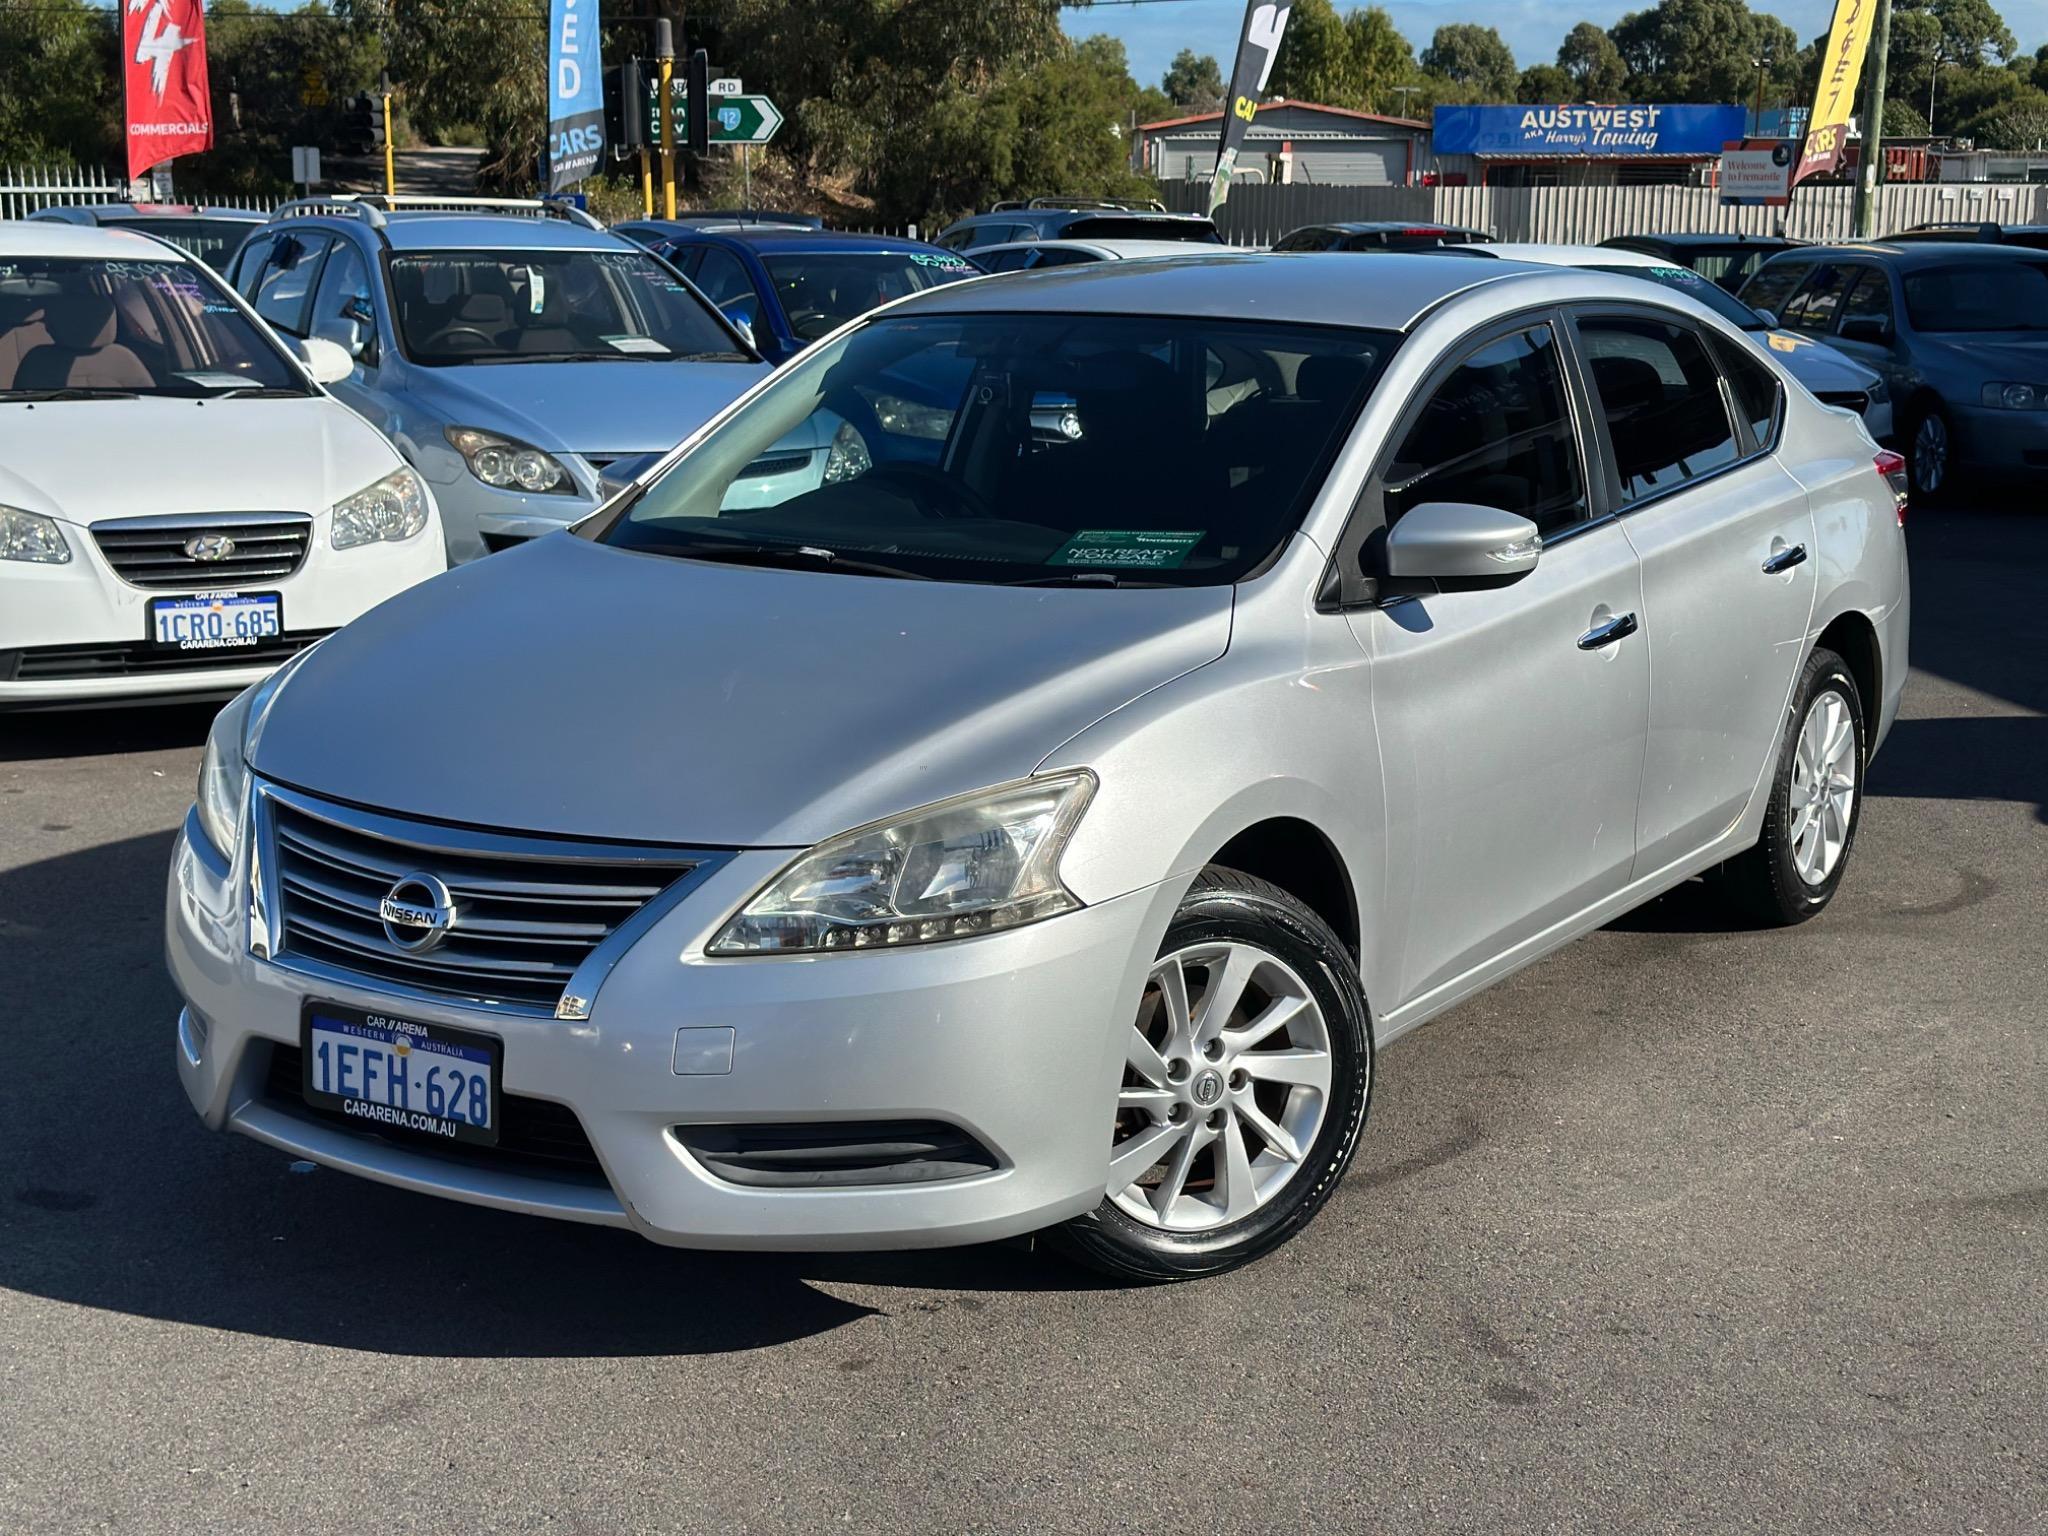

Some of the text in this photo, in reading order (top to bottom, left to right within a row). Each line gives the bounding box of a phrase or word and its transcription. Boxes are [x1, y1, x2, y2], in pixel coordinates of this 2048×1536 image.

[558, 0, 582, 99] ED
[718, 82, 736, 92] RD
[723, 111, 737, 125] 12
[1520, 109, 1660, 128] AUSTWEST
[130, 122, 208, 136] COMMERCIALS
[1524, 129, 1544, 140] AKA
[1592, 126, 1659, 150] Towing
[550, 124, 602, 160] CARS
[1728, 159, 1767, 170] Welcome
[1728, 172, 1781, 182] to Fremantle
[215, 591, 238, 599] ARENA
[180, 637, 257, 649] CARARENA.COM.AU
[383, 902, 438, 925] NISSAN
[367, 1015, 428, 1038] CAR ARENA
[342, 1025, 465, 1057] WESTERN AUSTRALIA
[344, 1099, 456, 1138] CARARENA.COM.AU
